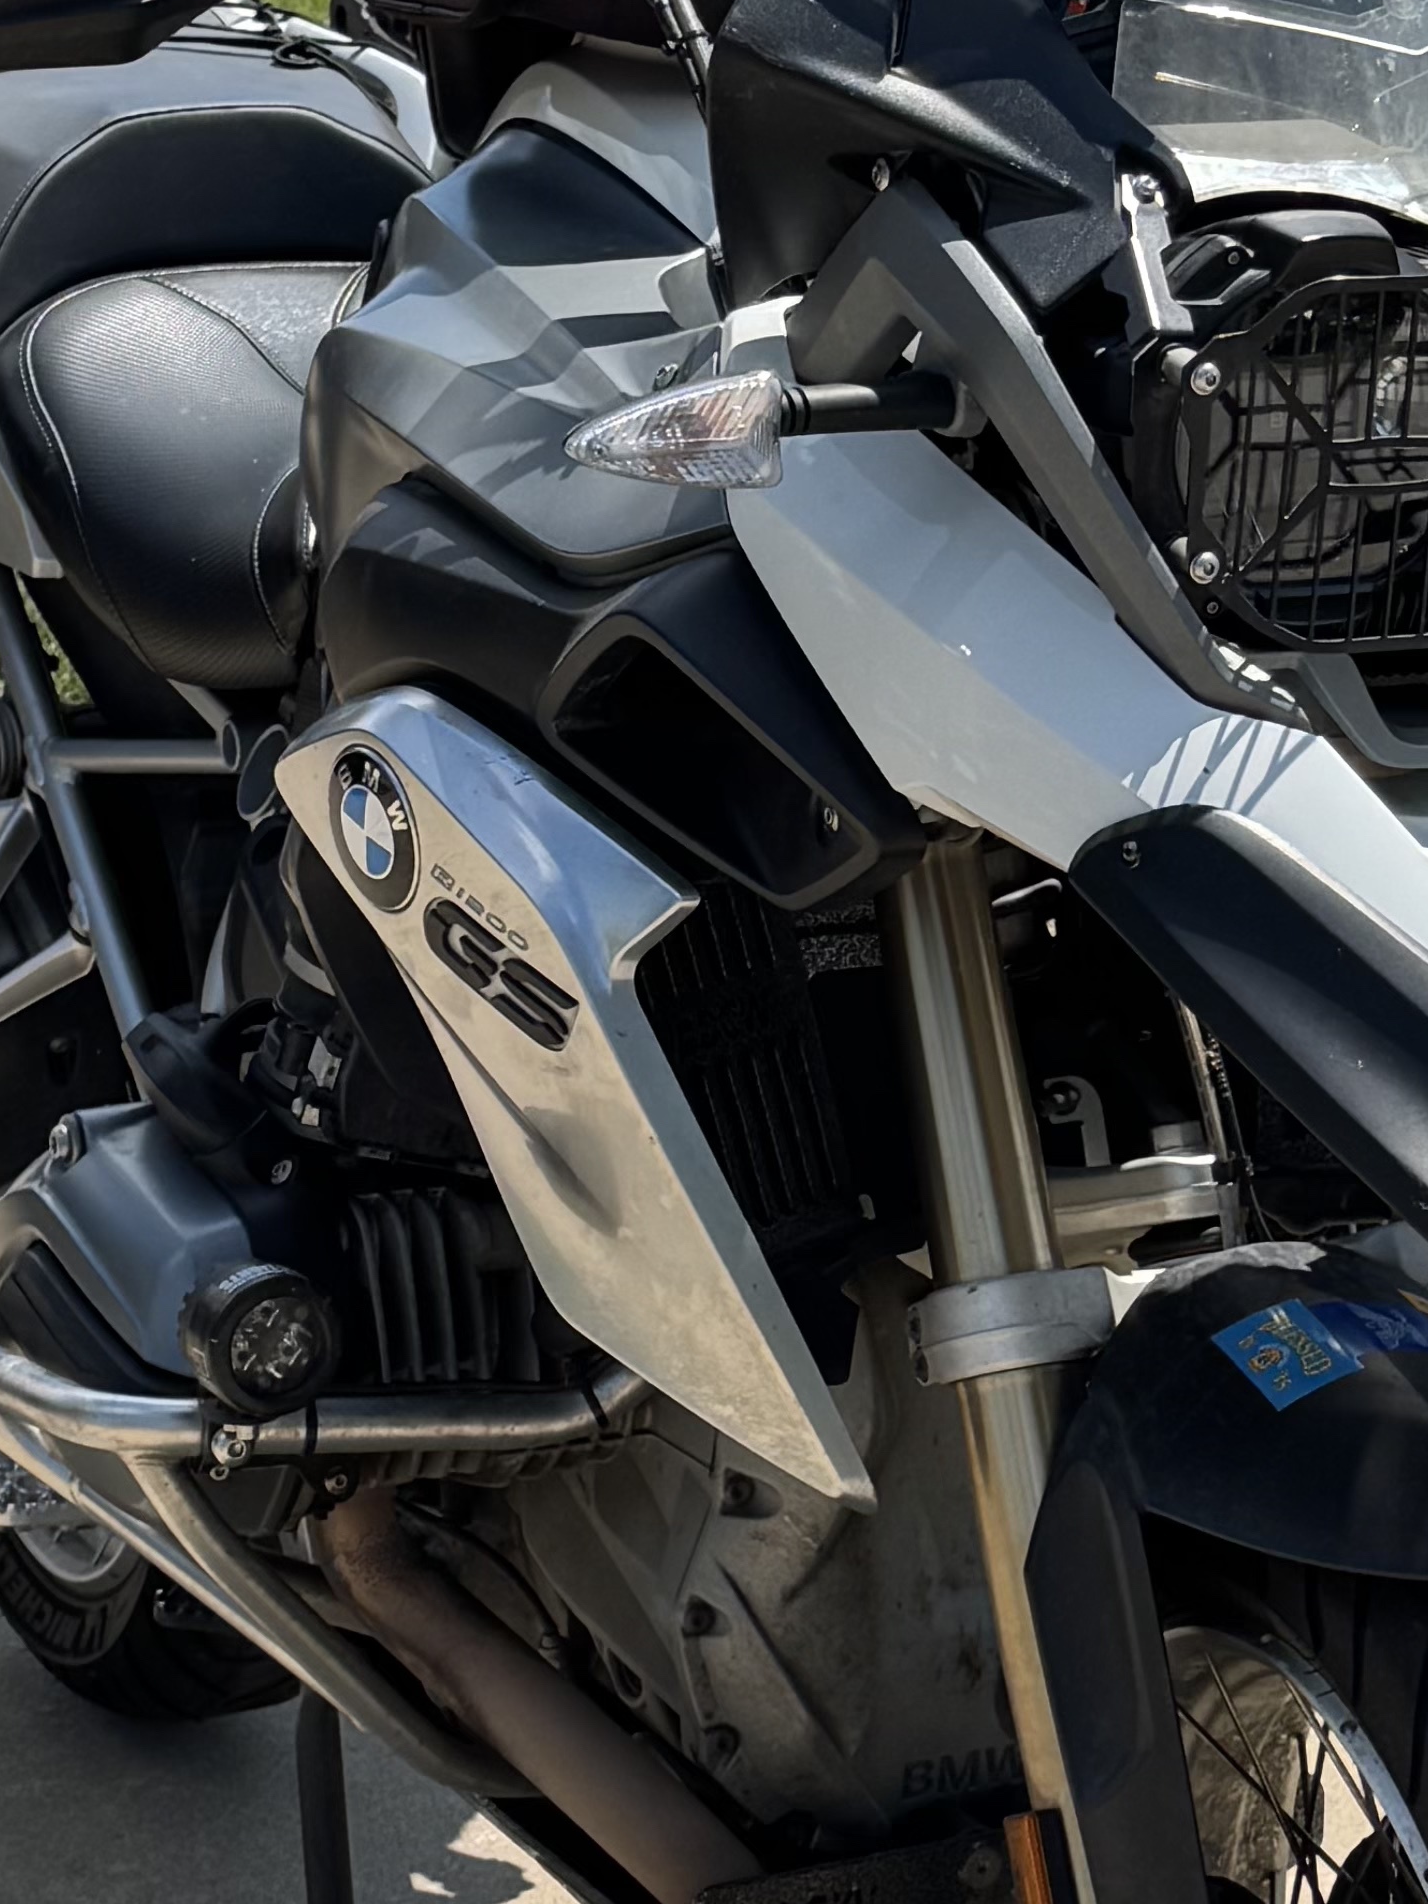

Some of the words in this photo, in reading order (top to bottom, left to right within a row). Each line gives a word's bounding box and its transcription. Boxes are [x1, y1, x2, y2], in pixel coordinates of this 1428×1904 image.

[335, 760, 409, 832] BMW
[429, 863, 531, 952] R1200
[423, 896, 581, 1052] GS
[901, 1743, 1024, 1799] BMW
